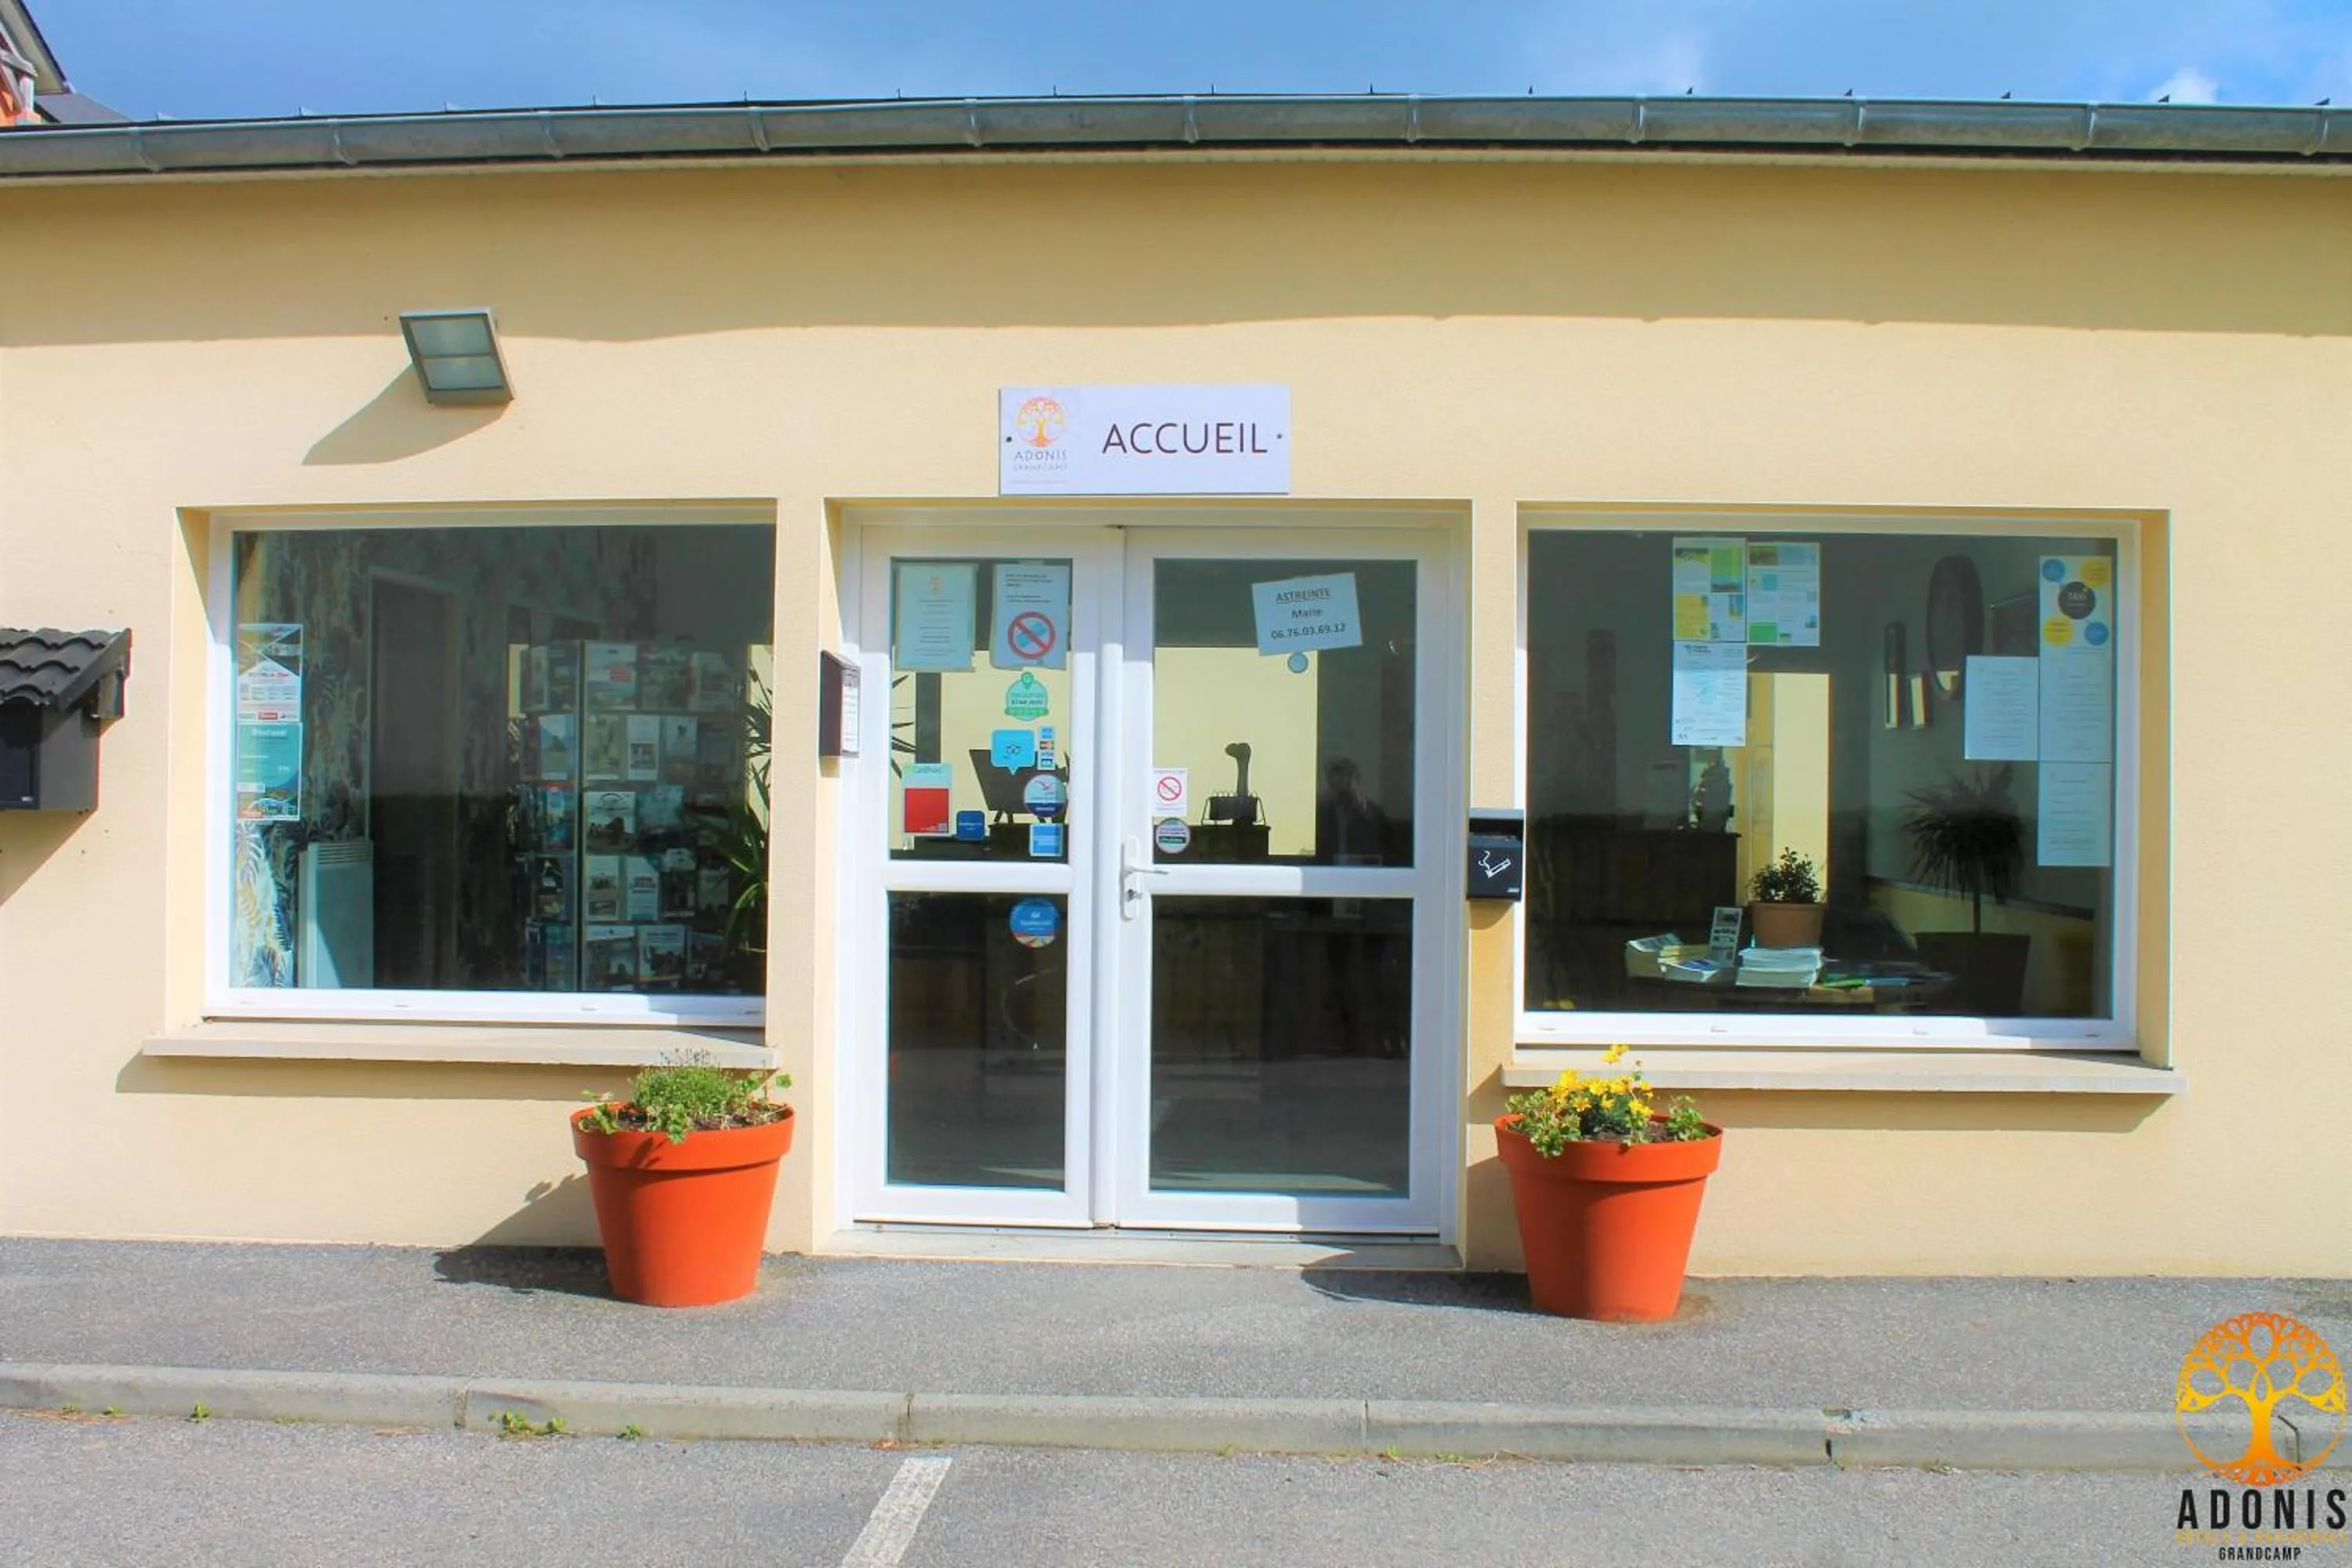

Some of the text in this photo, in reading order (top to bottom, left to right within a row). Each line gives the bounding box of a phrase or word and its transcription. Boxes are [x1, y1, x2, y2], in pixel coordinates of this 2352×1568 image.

[1102, 423, 1268, 454] ACCUEIL
[1276, 588, 1330, 603] ASTREINTE
[1290, 608, 1323, 619] Marie
